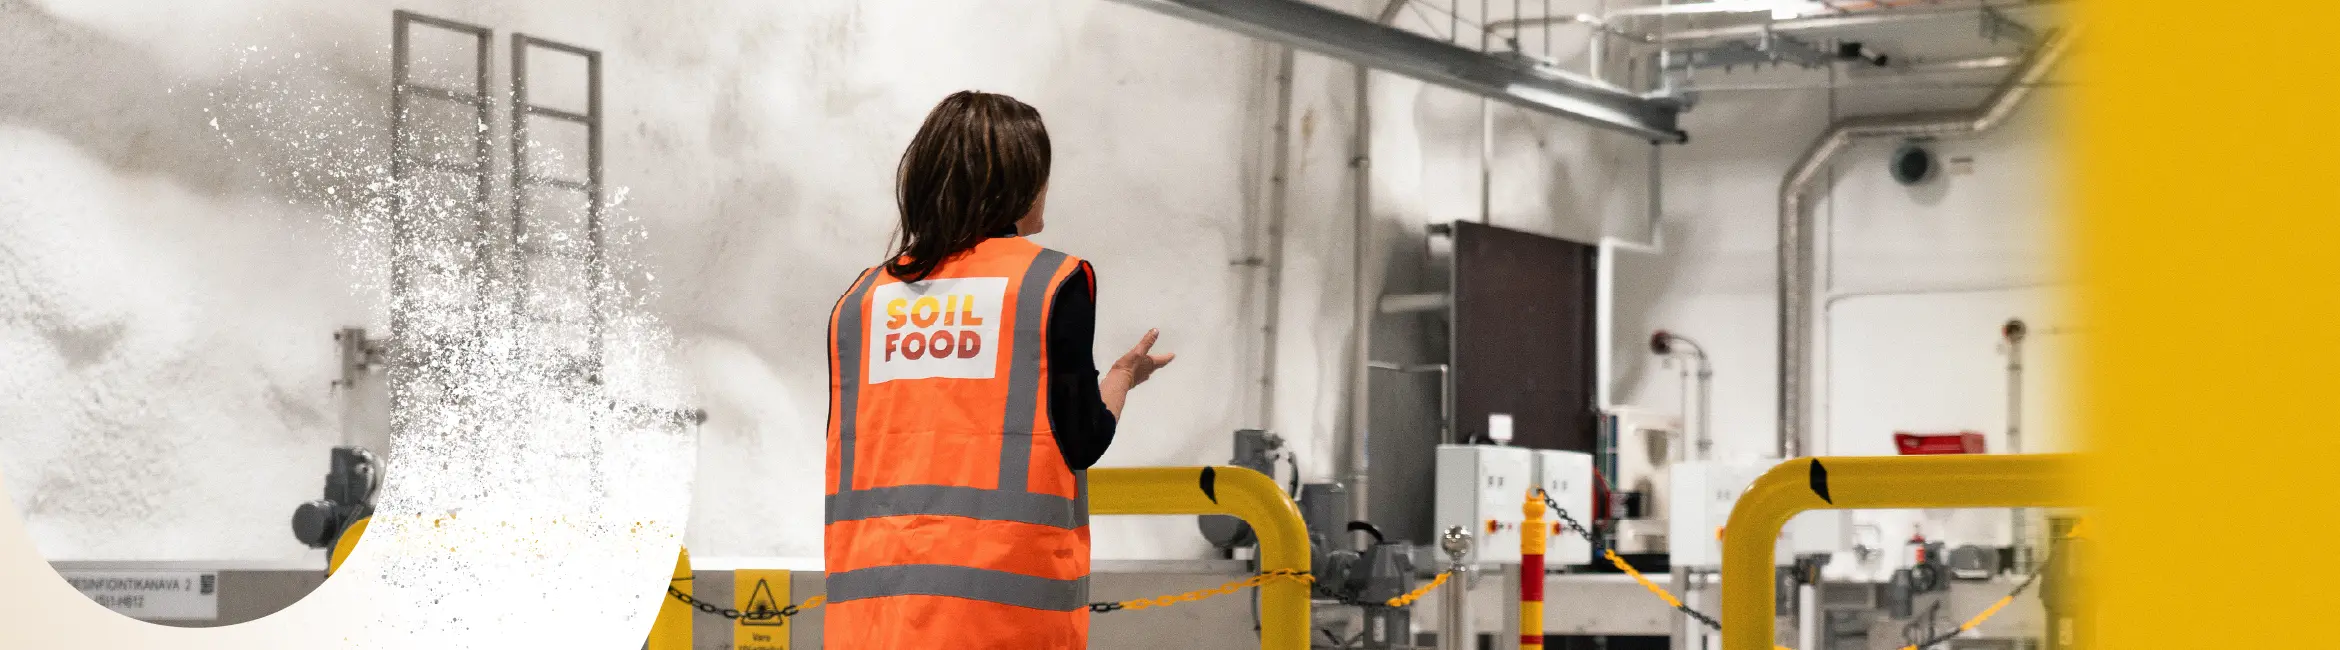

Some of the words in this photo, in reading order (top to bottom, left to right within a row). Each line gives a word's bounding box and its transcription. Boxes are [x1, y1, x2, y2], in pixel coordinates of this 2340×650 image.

[886, 294, 983, 329] SOIL
[885, 330, 981, 362] FOOD
[185, 578, 192, 591] 2
